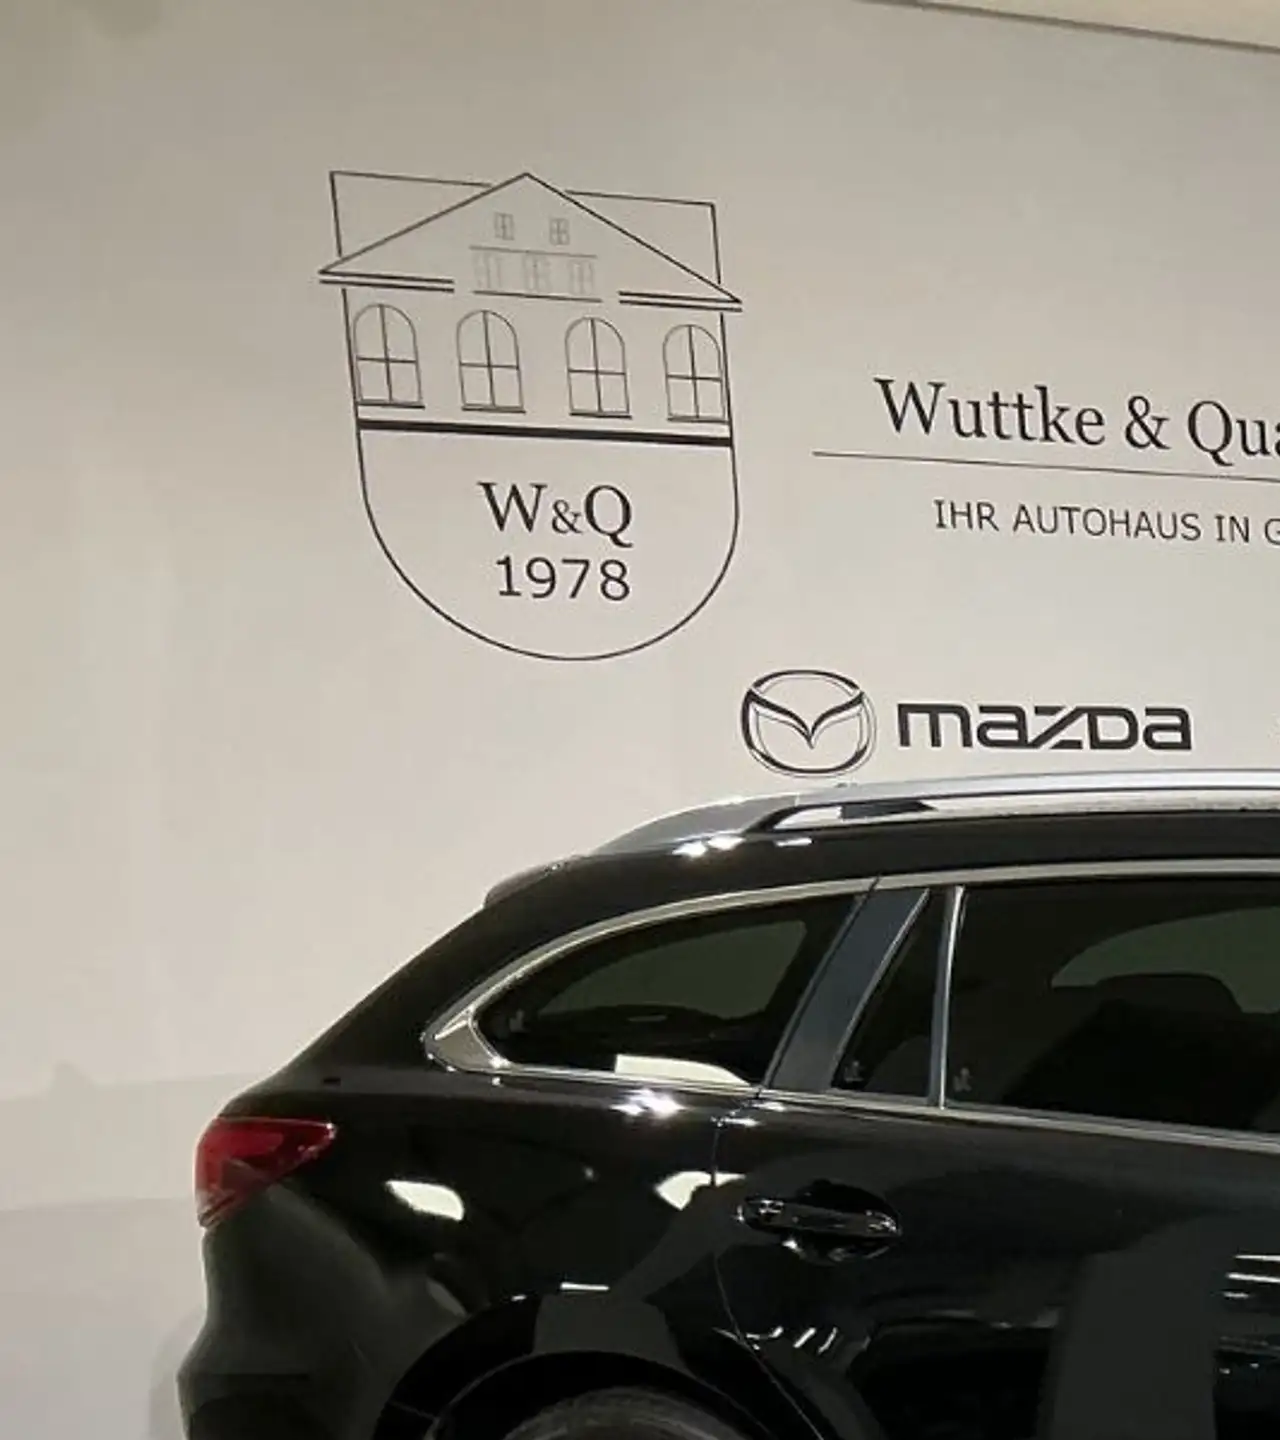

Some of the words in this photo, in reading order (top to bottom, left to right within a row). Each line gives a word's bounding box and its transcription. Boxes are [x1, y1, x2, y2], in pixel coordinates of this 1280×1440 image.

[873, 377, 1105, 446] Wuttke
[1125, 396, 1171, 450] &
[477, 481, 633, 548] W&Q
[934, 499, 999, 532] IHR
[1013, 504, 1201, 542] AUTOHAUS
[1215, 514, 1249, 544] IN
[496, 555, 630, 601] 1978
